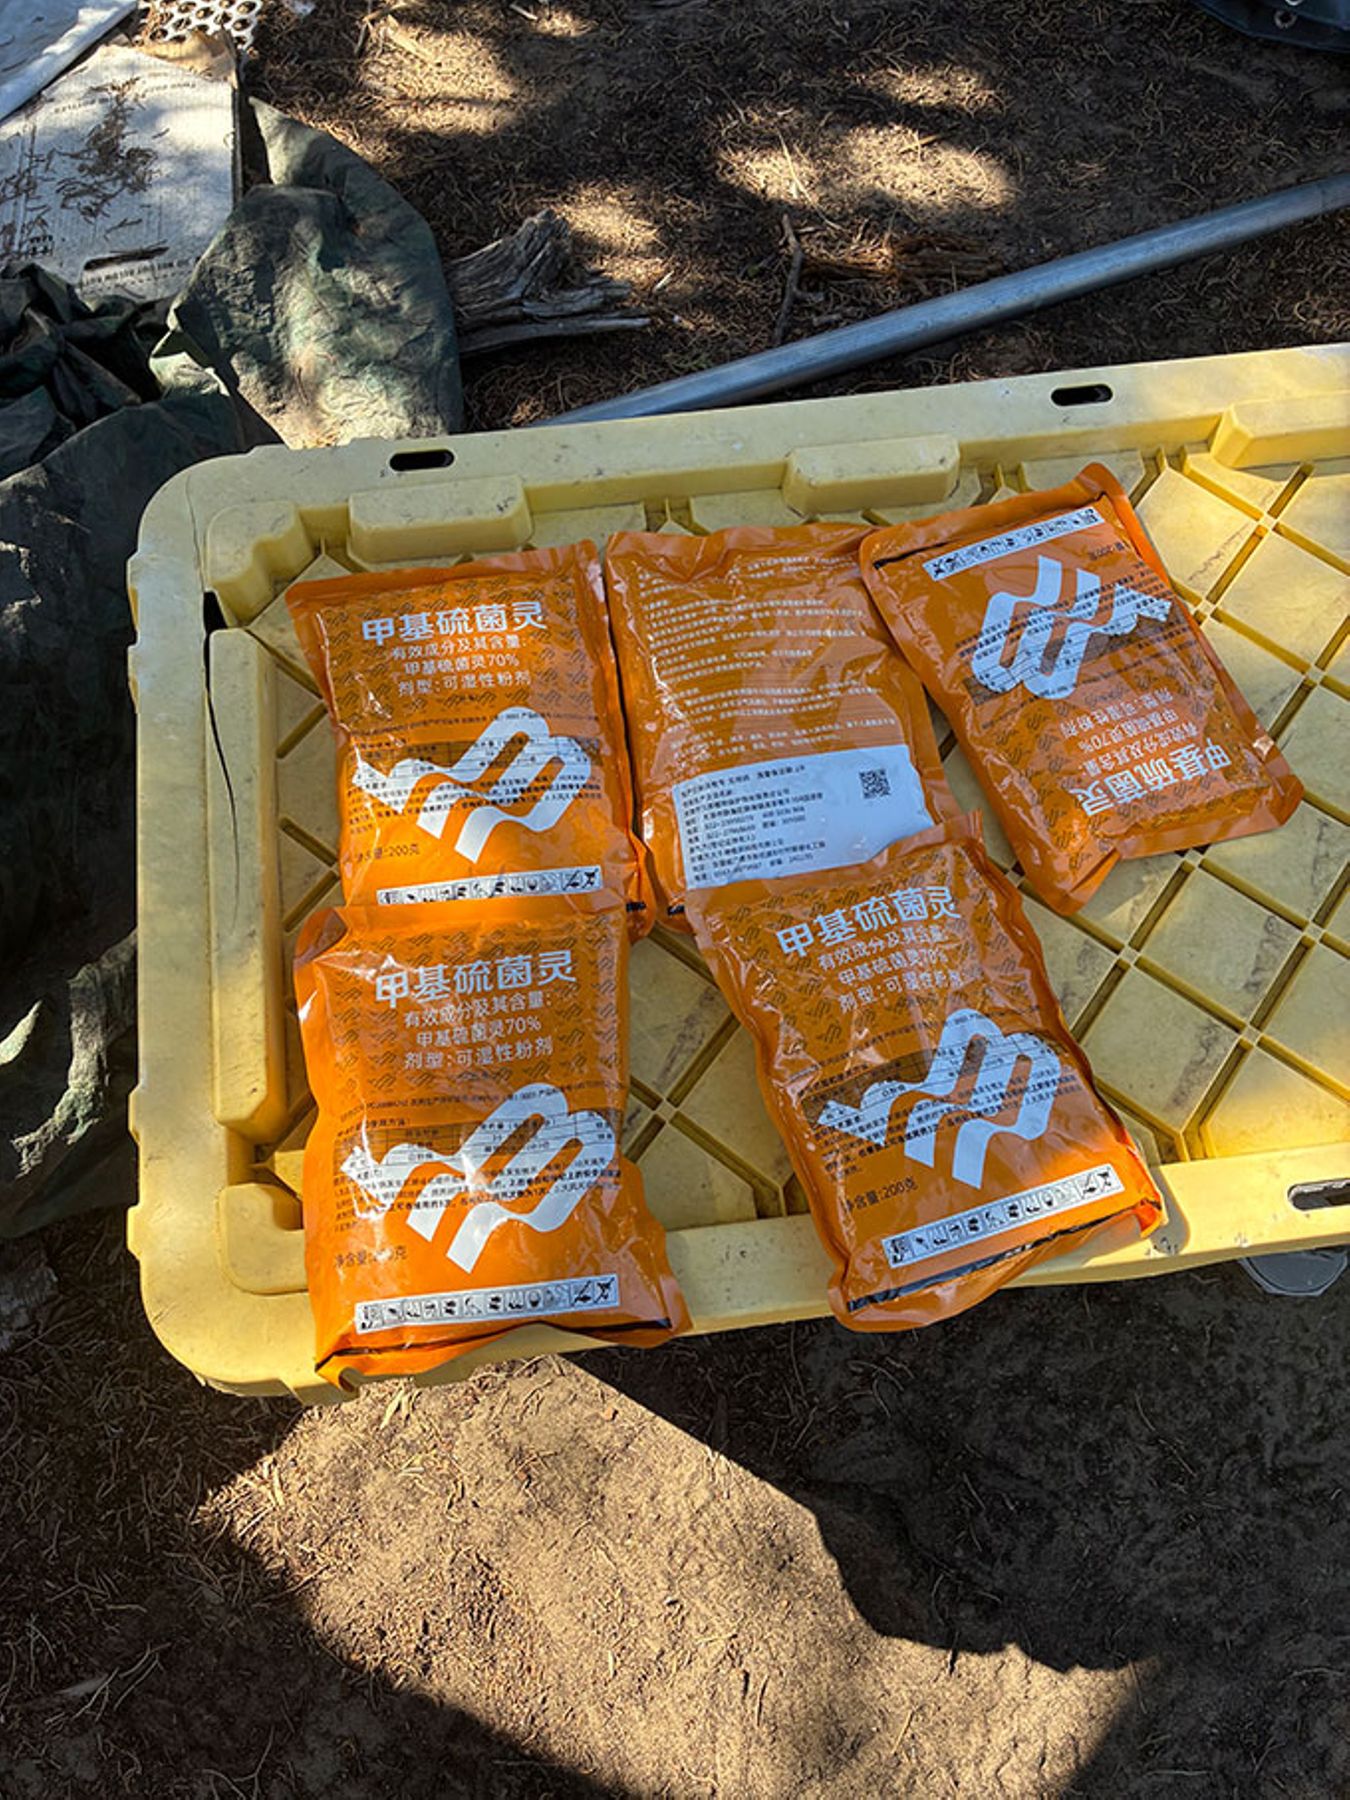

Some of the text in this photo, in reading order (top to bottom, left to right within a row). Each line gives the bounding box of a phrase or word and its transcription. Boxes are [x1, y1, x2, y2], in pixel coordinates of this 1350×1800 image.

[362, 601, 547, 646] 甲基硫菌灵
[404, 653, 519, 675] 甲基硫菌灵70%
[1068, 737, 1231, 816] 甲基硫菌灵
[776, 886, 961, 958] 甲基硫菌灵
[375, 950, 576, 1009] 甲基硫菌灵
[404, 990, 552, 1027] 有效成分及其含量:
[416, 1016, 541, 1047] 甲基硫菌灵70%
[404, 1037, 553, 1069] 剂型:可湿性粉剂
